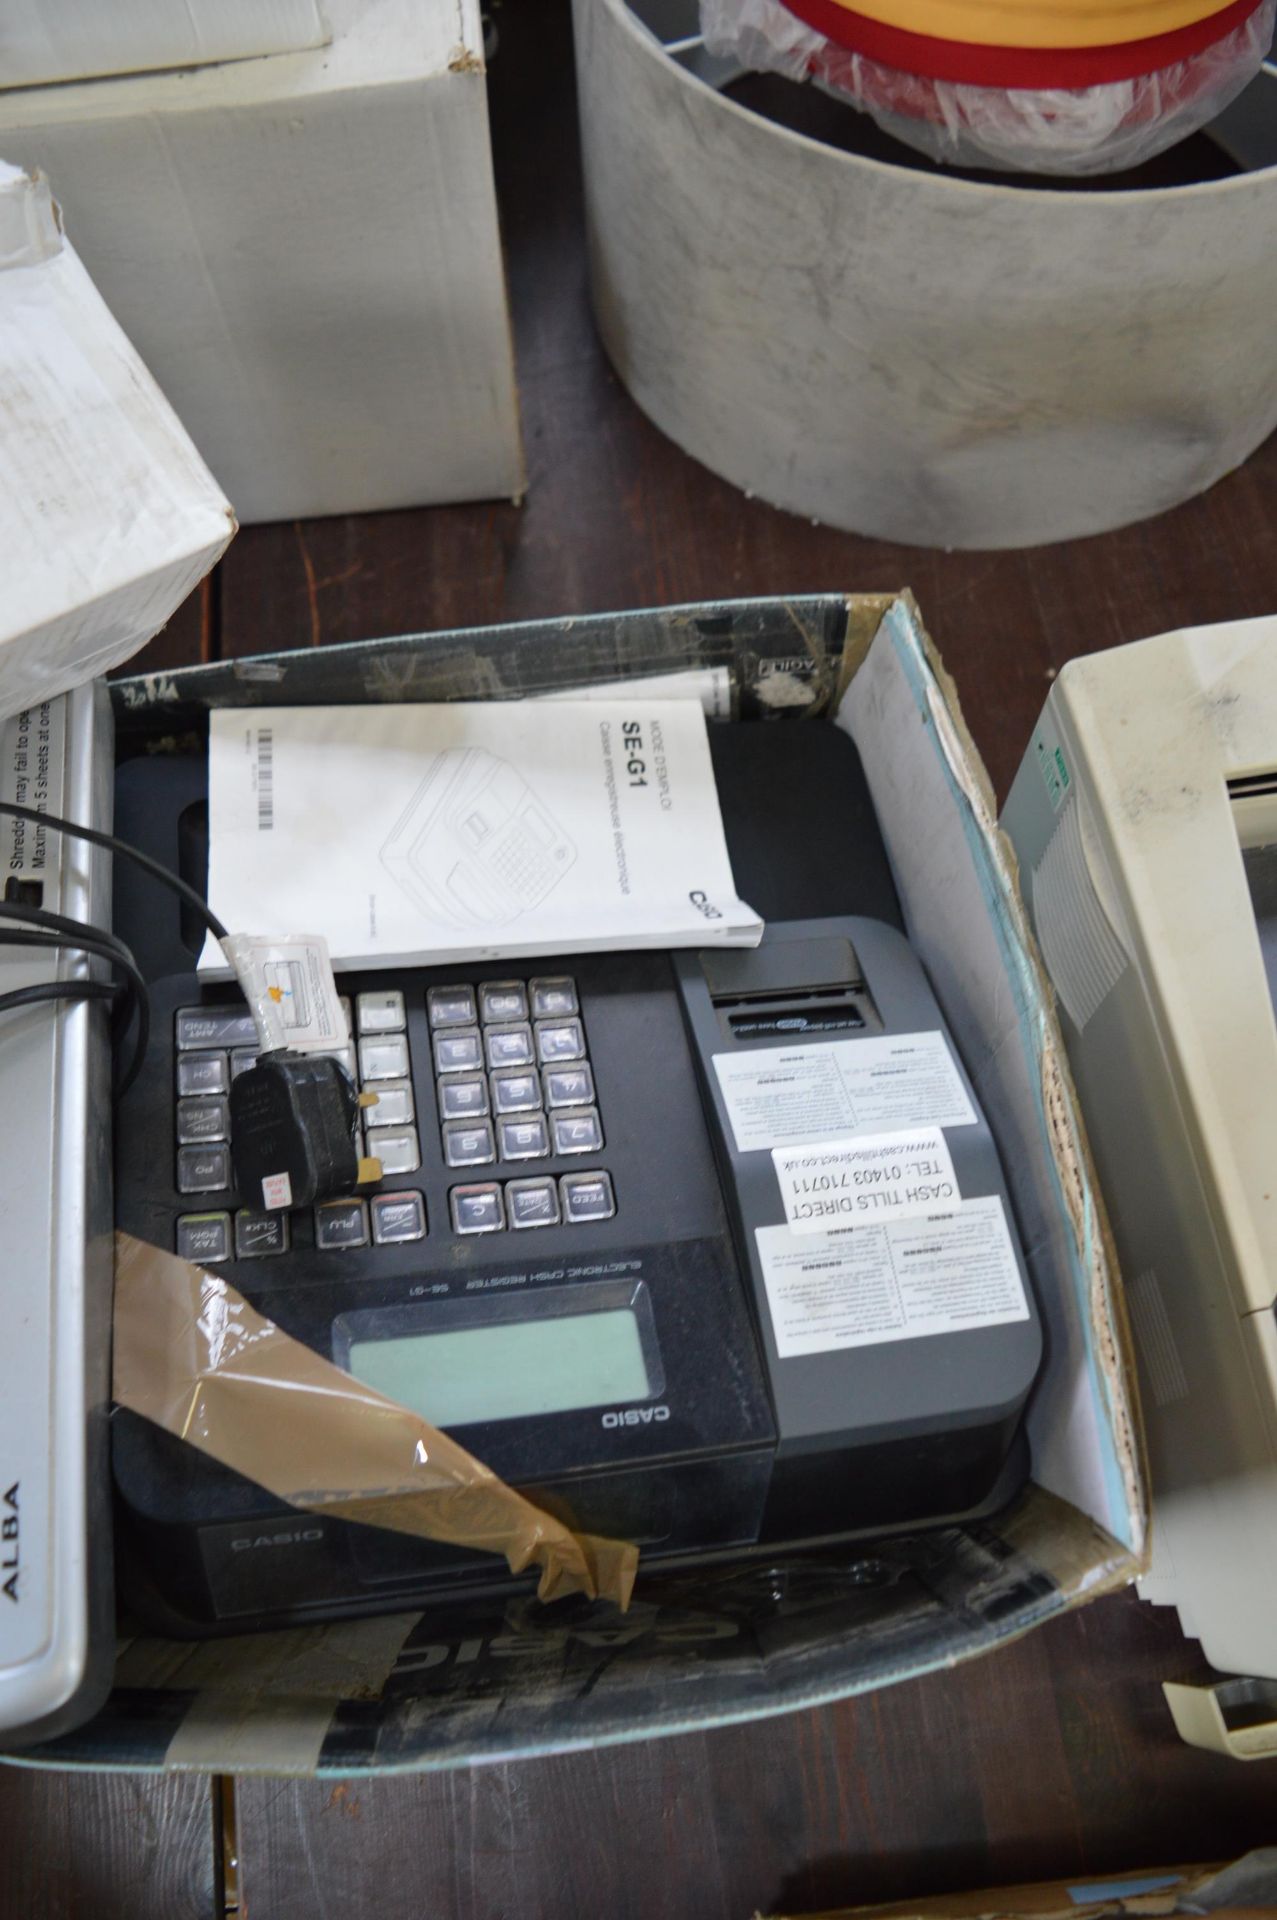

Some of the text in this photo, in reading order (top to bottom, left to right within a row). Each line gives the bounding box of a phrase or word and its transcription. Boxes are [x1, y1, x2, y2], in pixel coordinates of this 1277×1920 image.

[38, 728, 49, 742] at
[622, 721, 648, 787] SE-G1
[35, 745, 49, 788] sheets
[9, 709, 31, 870] Shredd may fail to ope
[34, 791, 47, 800] 5
[32, 802, 47, 869] Maximm
[462, 1125, 585, 1151] 7 8 9
[784, 1140, 937, 1172] www.cashtillsdirect.co.uk
[792, 1159, 943, 1194] TEL: 01403 710711
[572, 1193, 604, 1204] FEED
[792, 1182, 953, 1220] CASH TILLS DIRECT
[472, 1204, 486, 1216] C
[328, 1219, 355, 1230] PLU
[192, 1239, 217, 1249] TAX
[530, 1269, 565, 1282] CASH
[565, 1260, 643, 1278] ELECTRONIC
[466, 1274, 527, 1290] REGISTER
[601, 1406, 670, 1429] CASIO
[3, 1481, 20, 1603] ALBA
[231, 1529, 324, 1550] CASIO
